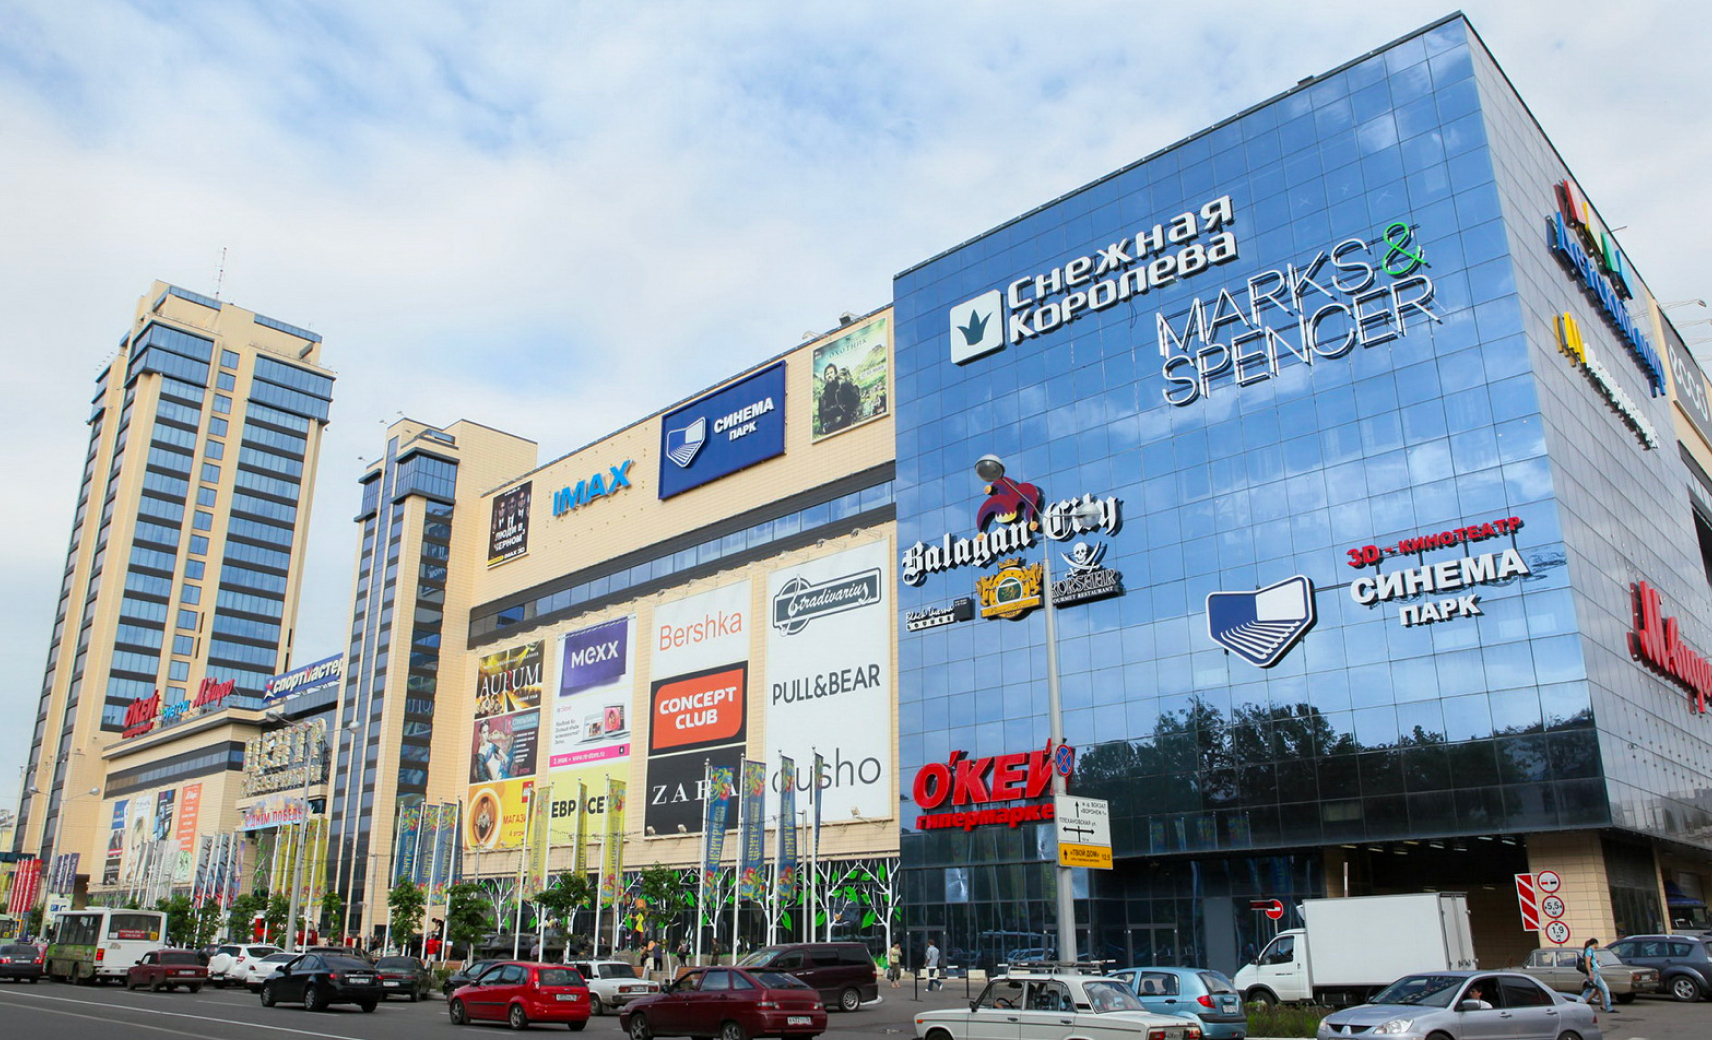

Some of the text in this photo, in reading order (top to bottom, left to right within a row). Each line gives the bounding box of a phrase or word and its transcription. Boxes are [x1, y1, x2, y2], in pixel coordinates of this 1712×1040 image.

[1162, 274, 1443, 408] SPENCER
[713, 396, 774, 434] СИНЕМА
[728, 420, 757, 442] ПАРК
[552, 459, 633, 517] IMAX
[902, 493, 1118, 586] Balagan City
[1052, 586, 1114, 604] OURMET RESTAURANT
[1350, 548, 1529, 604] СИНЕМА
[779, 574, 872, 637] Stradivarius
[1399, 594, 1481, 627] ПАРК
[659, 611, 743, 651] Bershka
[480, 662, 542, 697] AURUM
[773, 664, 881, 706] PULL&BEAR
[659, 686, 737, 716] CONCEPT
[675, 709, 718, 731] CLUB
[916, 803, 1055, 832] гипермарке
